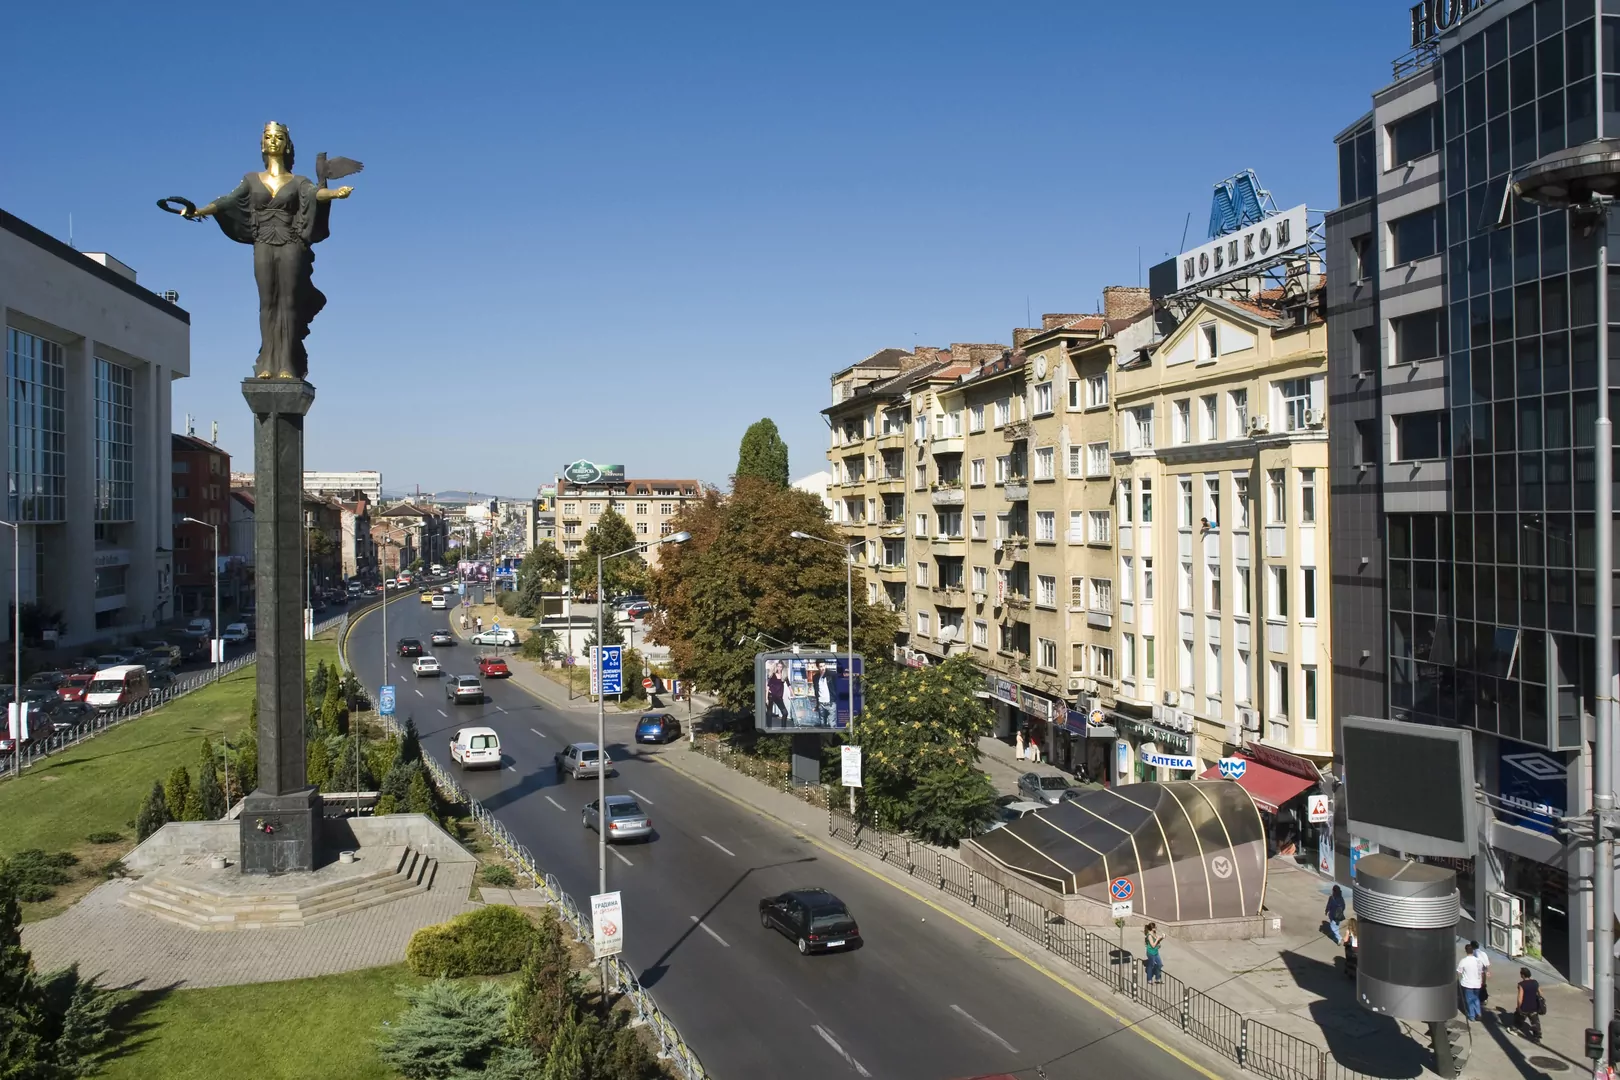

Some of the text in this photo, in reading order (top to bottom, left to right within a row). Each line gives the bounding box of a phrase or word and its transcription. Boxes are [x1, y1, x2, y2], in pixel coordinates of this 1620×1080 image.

[1183, 218, 1291, 283] МОБИКОМ
[1151, 755, 1193, 768] АПТЕКА
[1501, 793, 1567, 818] UMBR
[595, 901, 618, 909] ГРАДИНА
